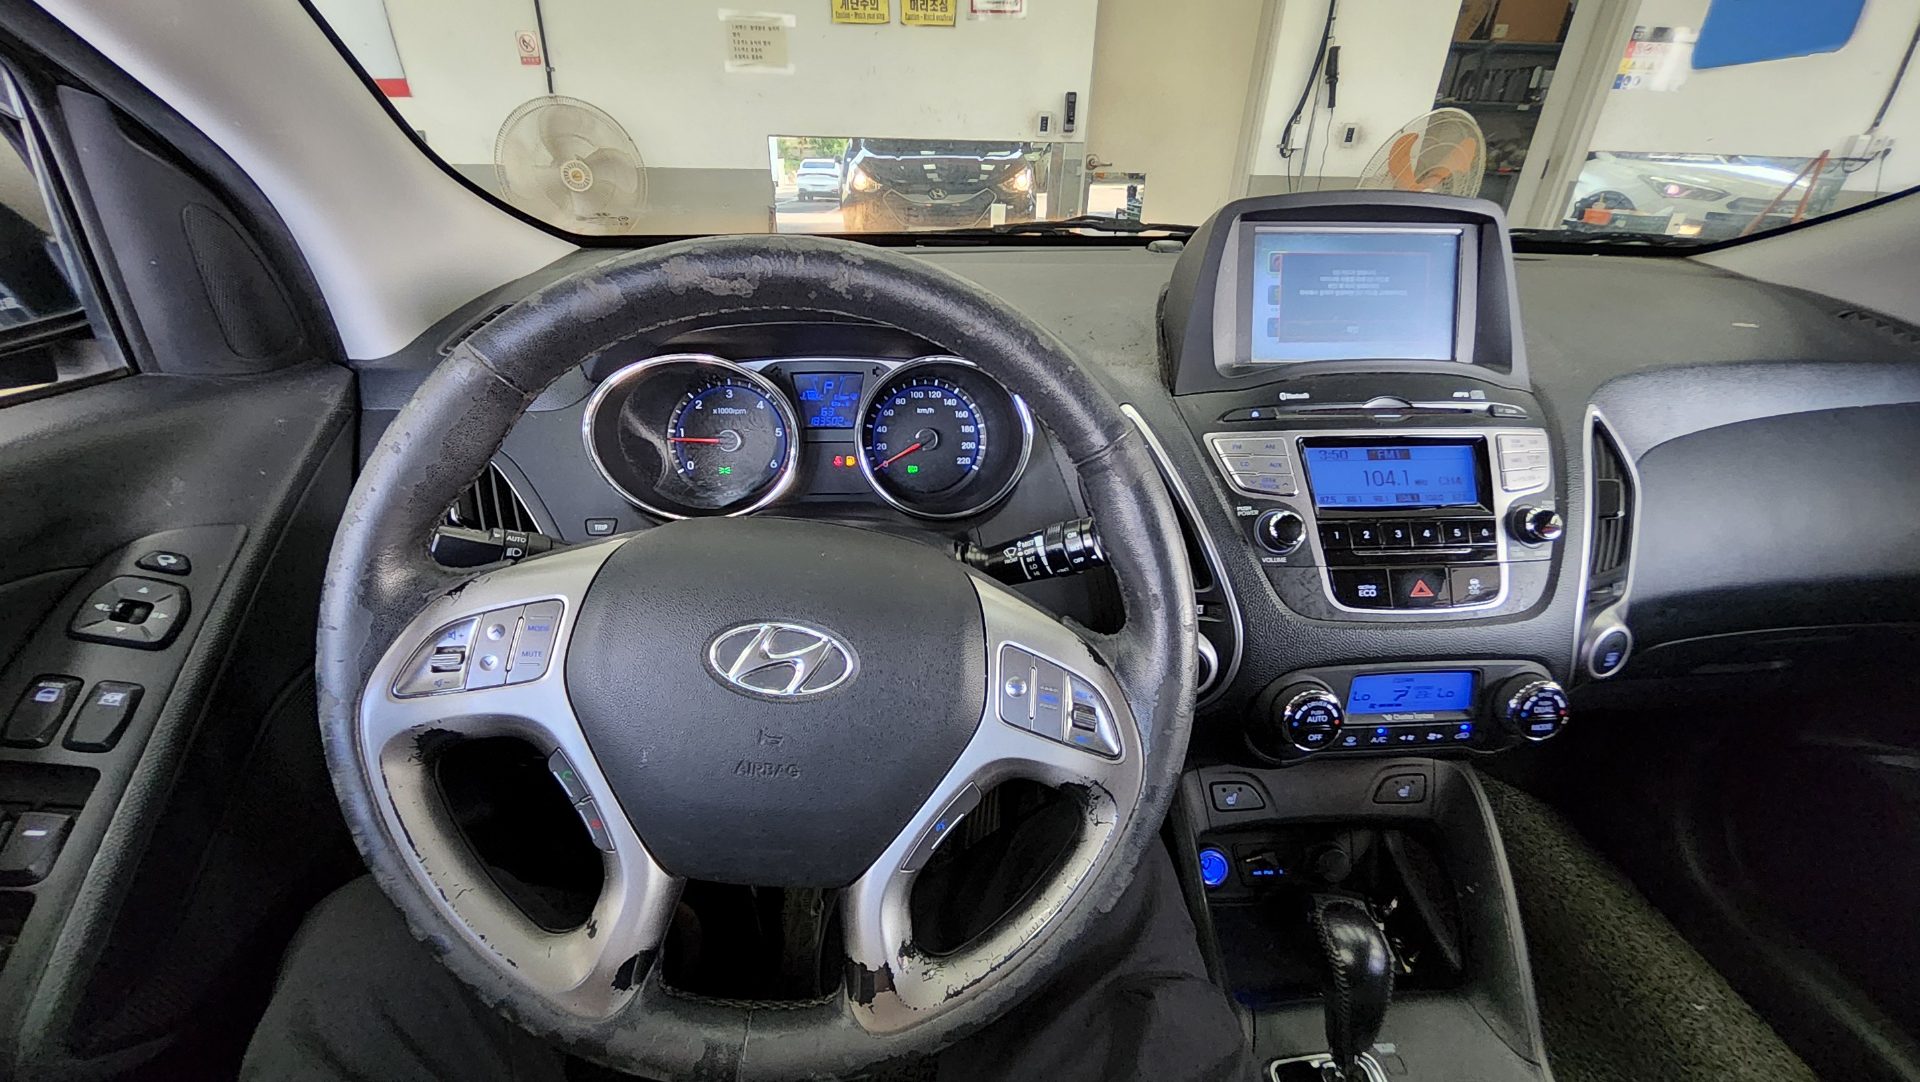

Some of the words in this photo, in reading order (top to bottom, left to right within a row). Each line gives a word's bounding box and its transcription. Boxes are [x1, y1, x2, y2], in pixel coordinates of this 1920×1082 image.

[910, 0, 948, 12] 머리조심
[824, 381, 834, 395] P
[726, 389, 734, 399] 3
[910, 391, 924, 399] 100
[928, 391, 942, 399] 120
[695, 400, 703, 410] 2
[756, 400, 764, 410] 4
[943, 398, 957, 406] 140
[883, 409, 894, 417] 60
[955, 410, 968, 418] 160
[679, 428, 684, 437] 1
[775, 428, 783, 437] 5
[876, 425, 887, 433] 40
[961, 425, 975, 433] 180
[876, 442, 887, 450] 20
[1319, 450, 1348, 460] 3:50
[770, 459, 778, 469] 6
[956, 457, 971, 465] 220
[686, 461, 695, 470] 0
[1363, 470, 1410, 486] 104.1
[1334, 531, 1340, 539] 1
[1363, 530, 1370, 539] 2
[1395, 530, 1402, 538] 3
[1423, 529, 1431, 537] 4
[1454, 528, 1461, 537] 5
[1481, 528, 1489, 536] 6
[506, 535, 527, 543] AUTO
[1029, 563, 1038, 571] LO
[1358, 589, 1377, 597] ECO
[1306, 715, 1328, 723] AUTO
[1307, 733, 1324, 741] OFF
[734, 759, 801, 779] AIRBAG
